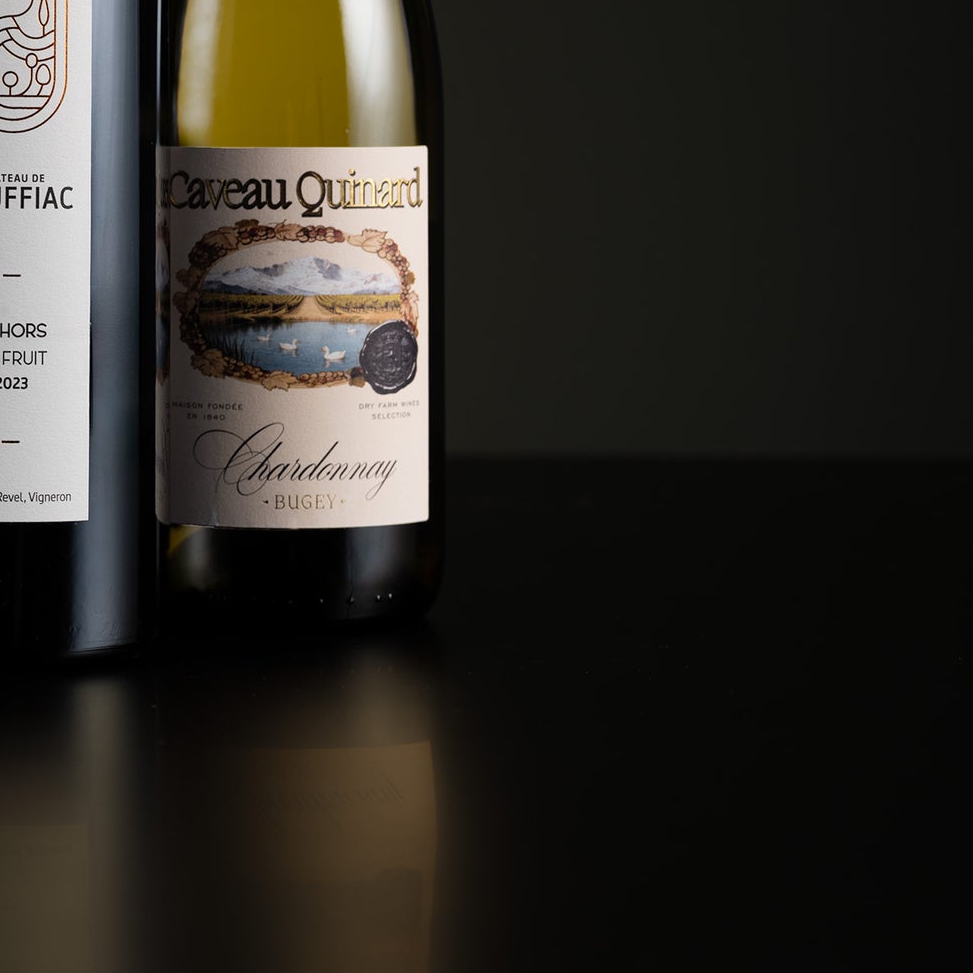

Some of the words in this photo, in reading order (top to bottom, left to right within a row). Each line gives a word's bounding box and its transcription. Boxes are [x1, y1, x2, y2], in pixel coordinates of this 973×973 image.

[31, 174, 45, 183] DE
[169, 170, 292, 210] Caveau
[296, 166, 424, 218] Quinard
[2, 350, 47, 366] FRUIT
[172, 401, 203, 409] MAISON
[207, 402, 244, 411] FONDÉE
[187, 413, 198, 421] EN
[203, 414, 226, 422] 1840
[372, 412, 411, 420] SELECTION
[193, 422, 397, 501] Chardonnay
[29, 491, 72, 504] Vigneron
[274, 494, 337, 510] BUGEY
